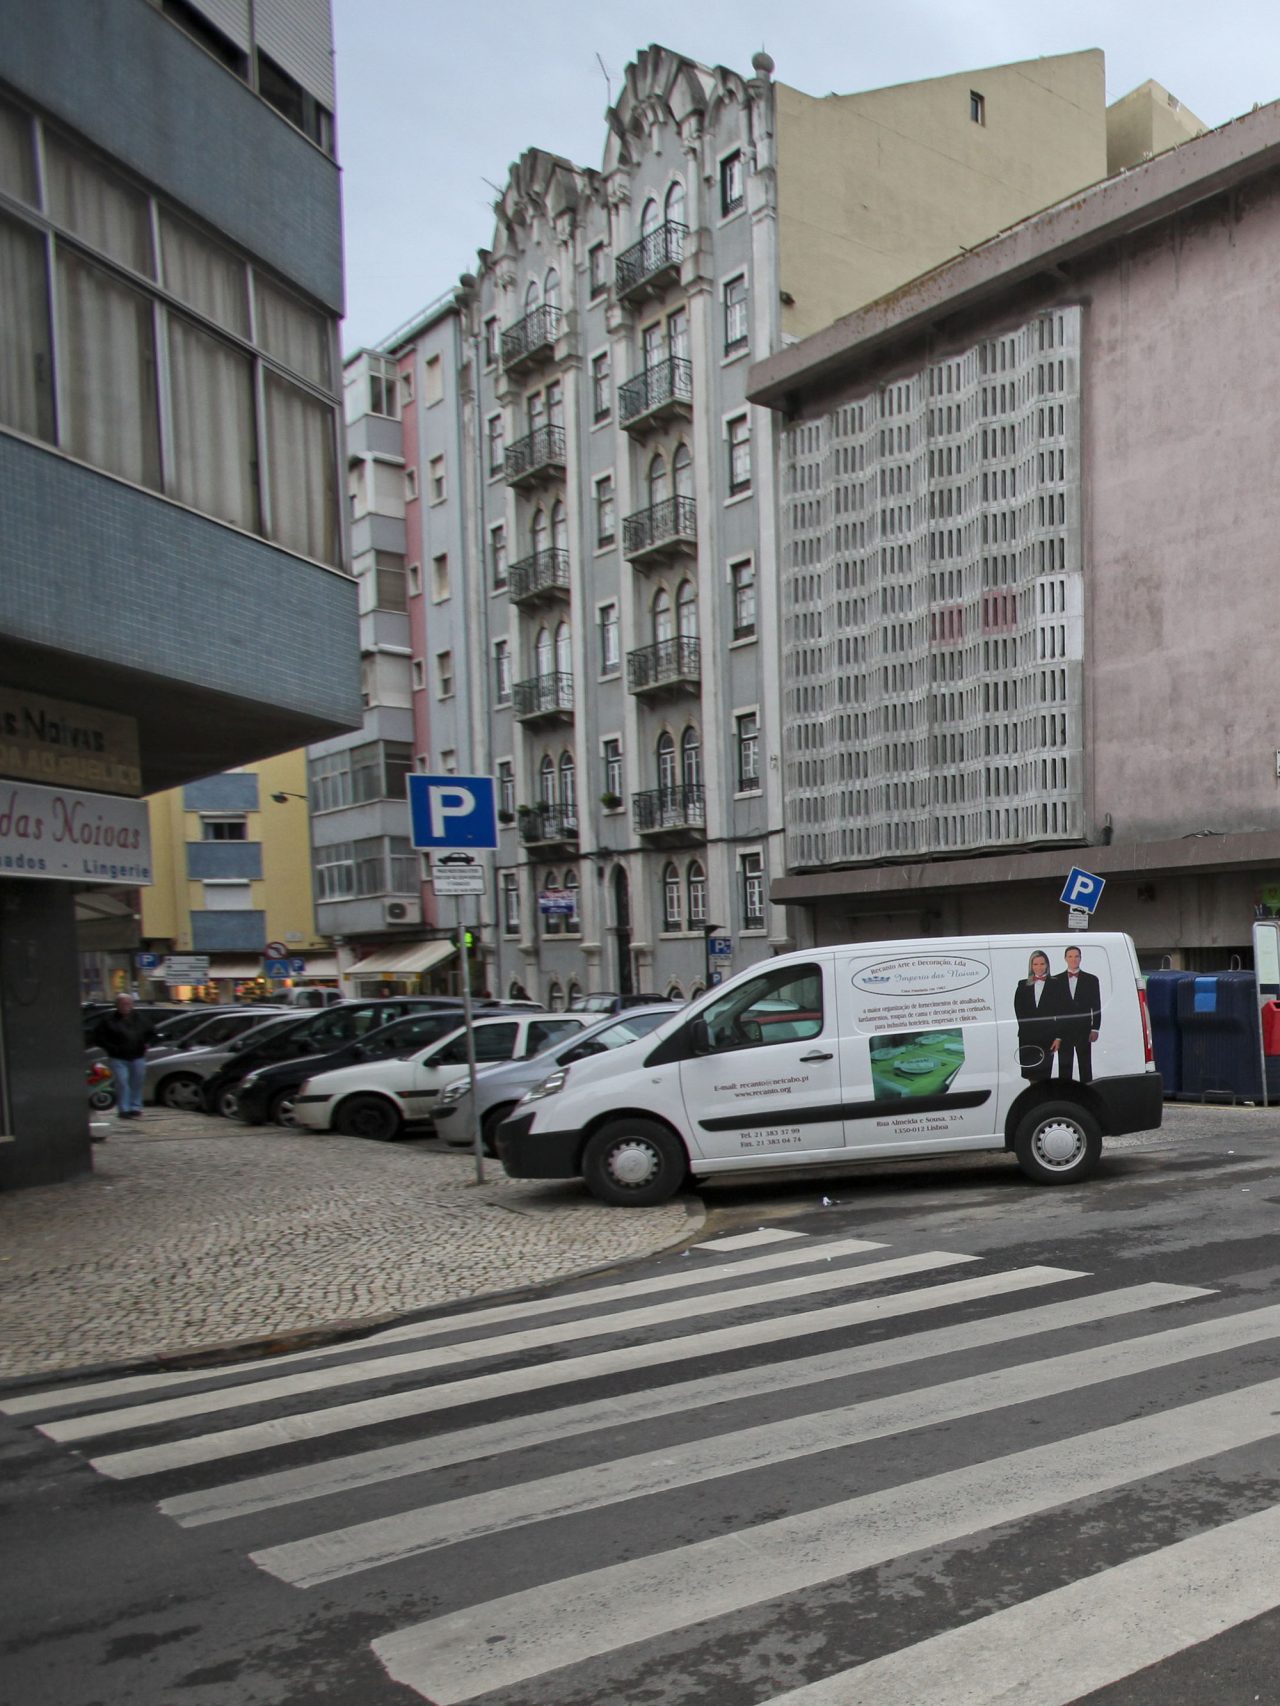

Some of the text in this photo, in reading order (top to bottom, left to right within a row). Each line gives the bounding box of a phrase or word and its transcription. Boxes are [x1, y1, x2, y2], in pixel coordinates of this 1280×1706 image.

[428, 786, 476, 838] P
[83, 859, 150, 878] Lingerie
[1070, 875, 1094, 900] P
